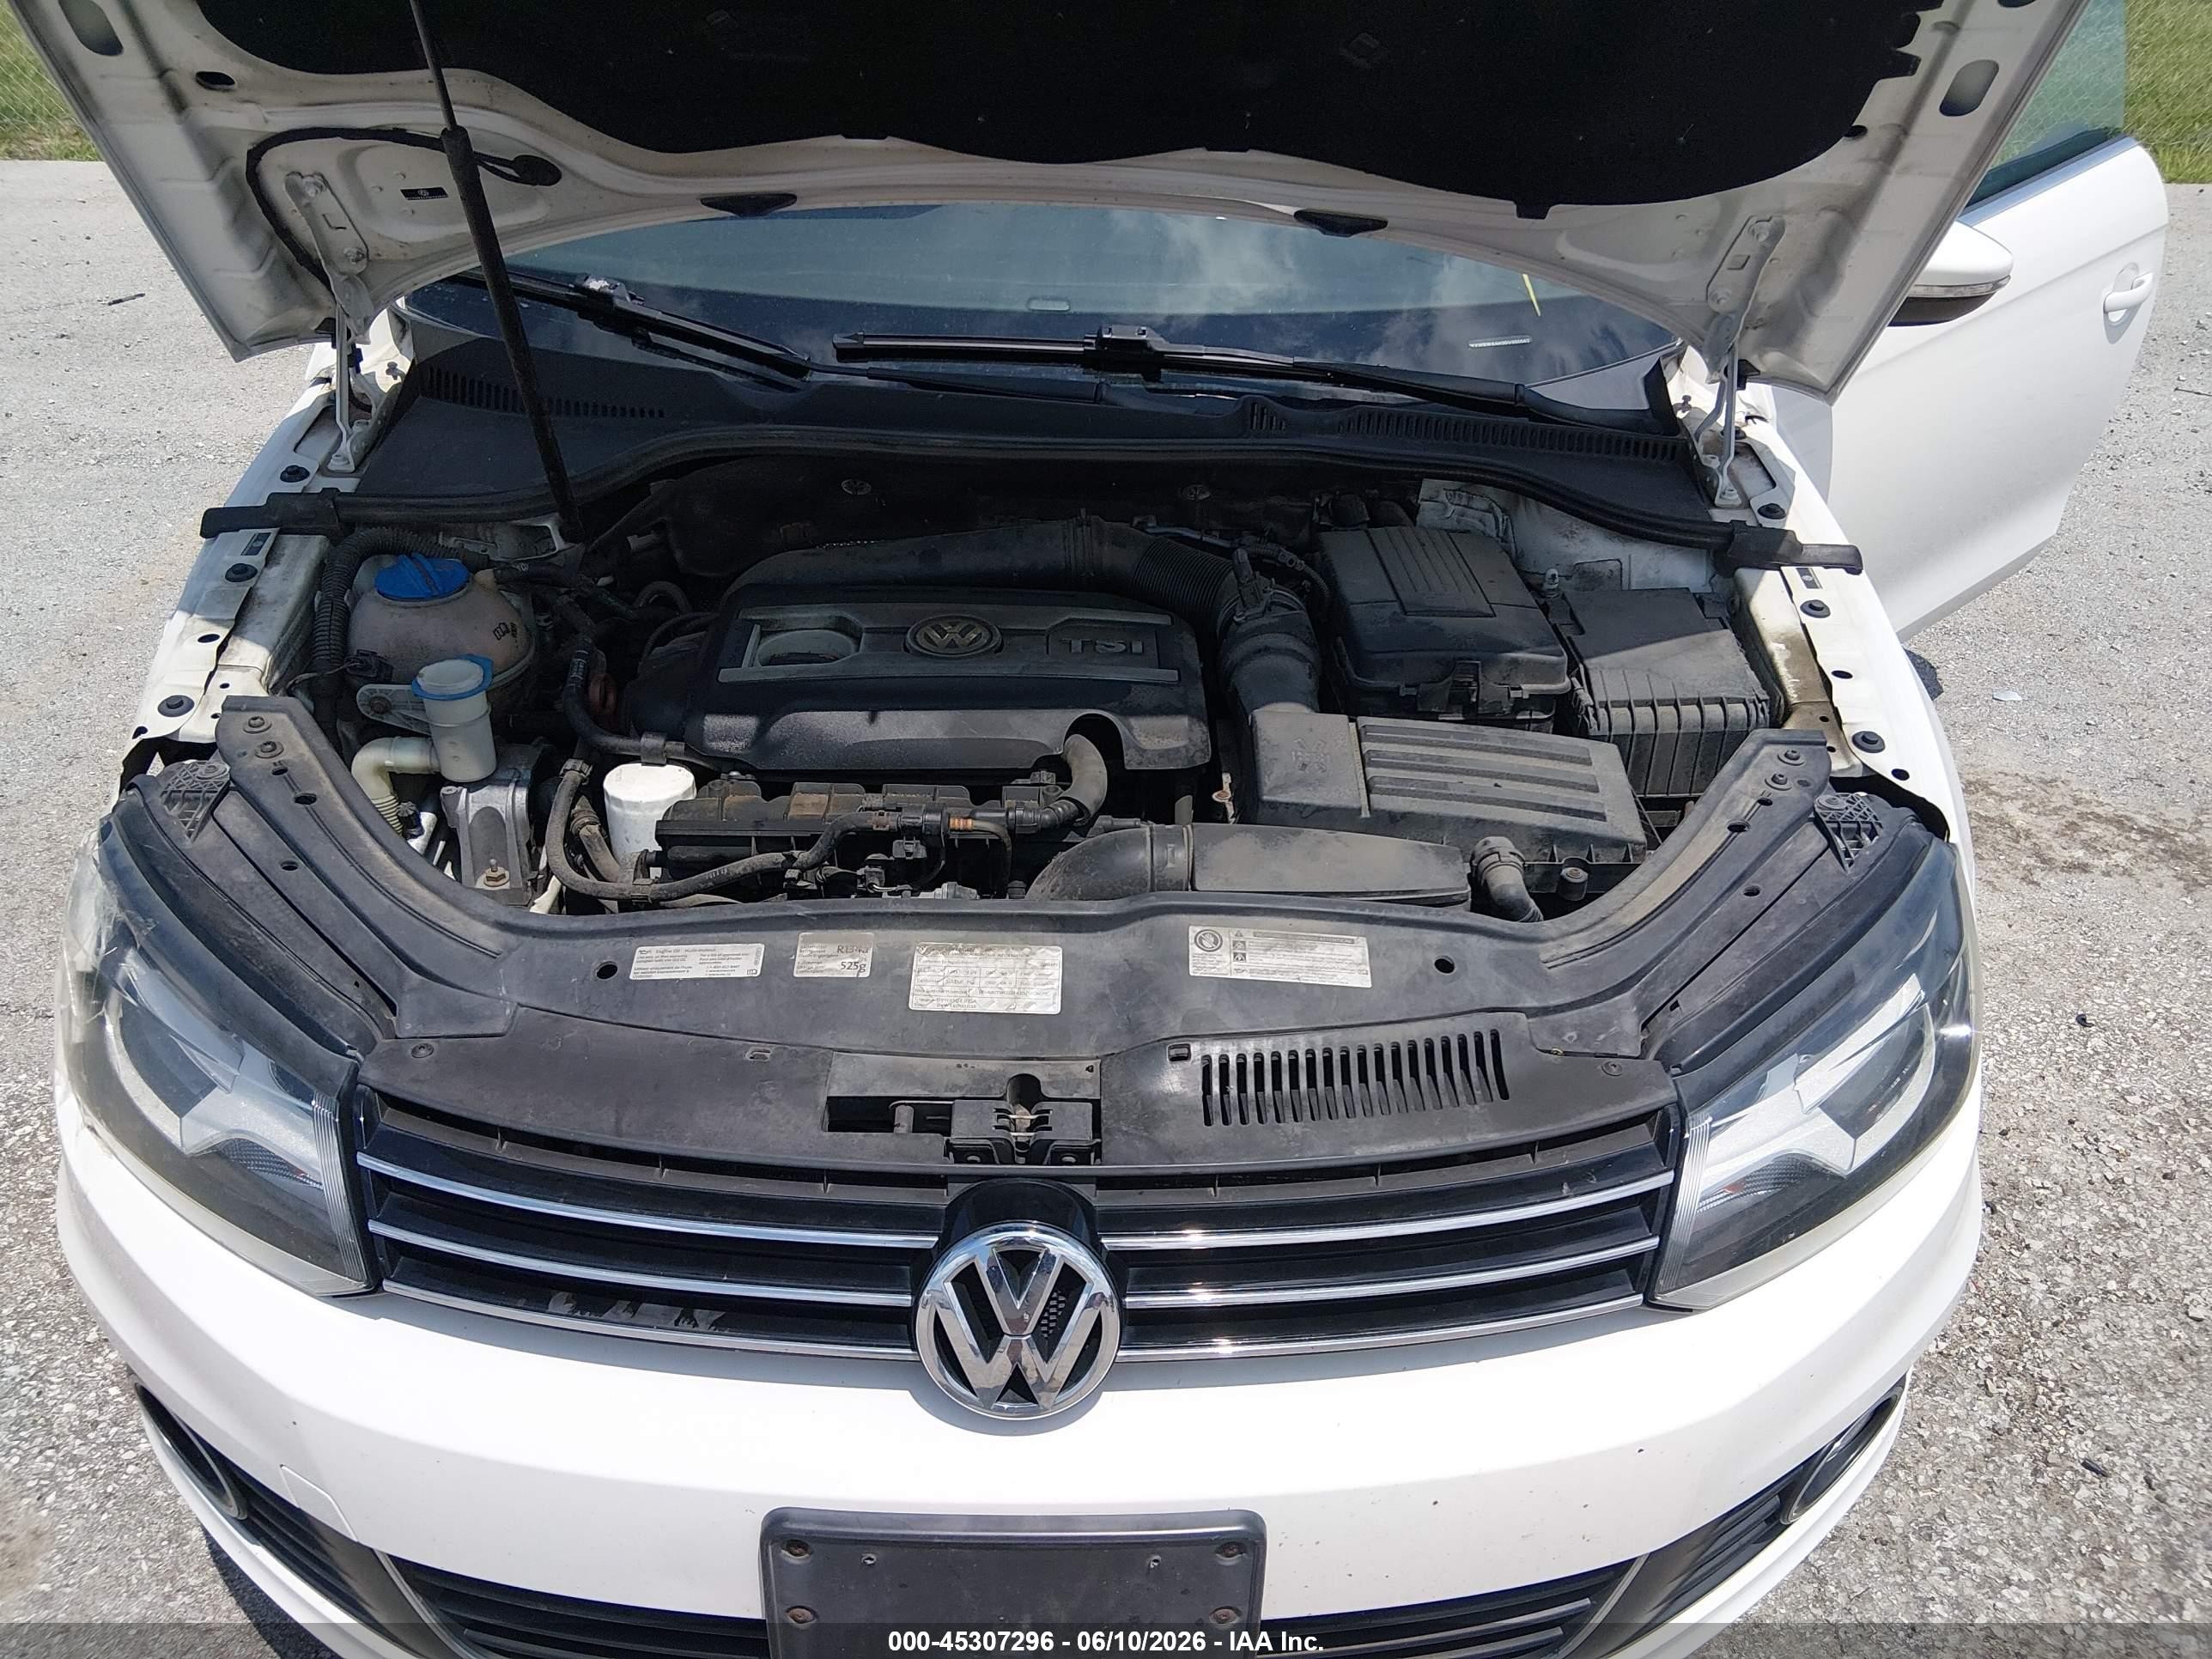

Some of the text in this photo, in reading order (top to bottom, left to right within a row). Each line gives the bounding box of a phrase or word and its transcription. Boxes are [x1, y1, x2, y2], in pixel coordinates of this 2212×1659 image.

[1059, 637, 1144, 653] TSI
[840, 961, 866, 973] 525g
[927, 1237, 1109, 1414] VW
